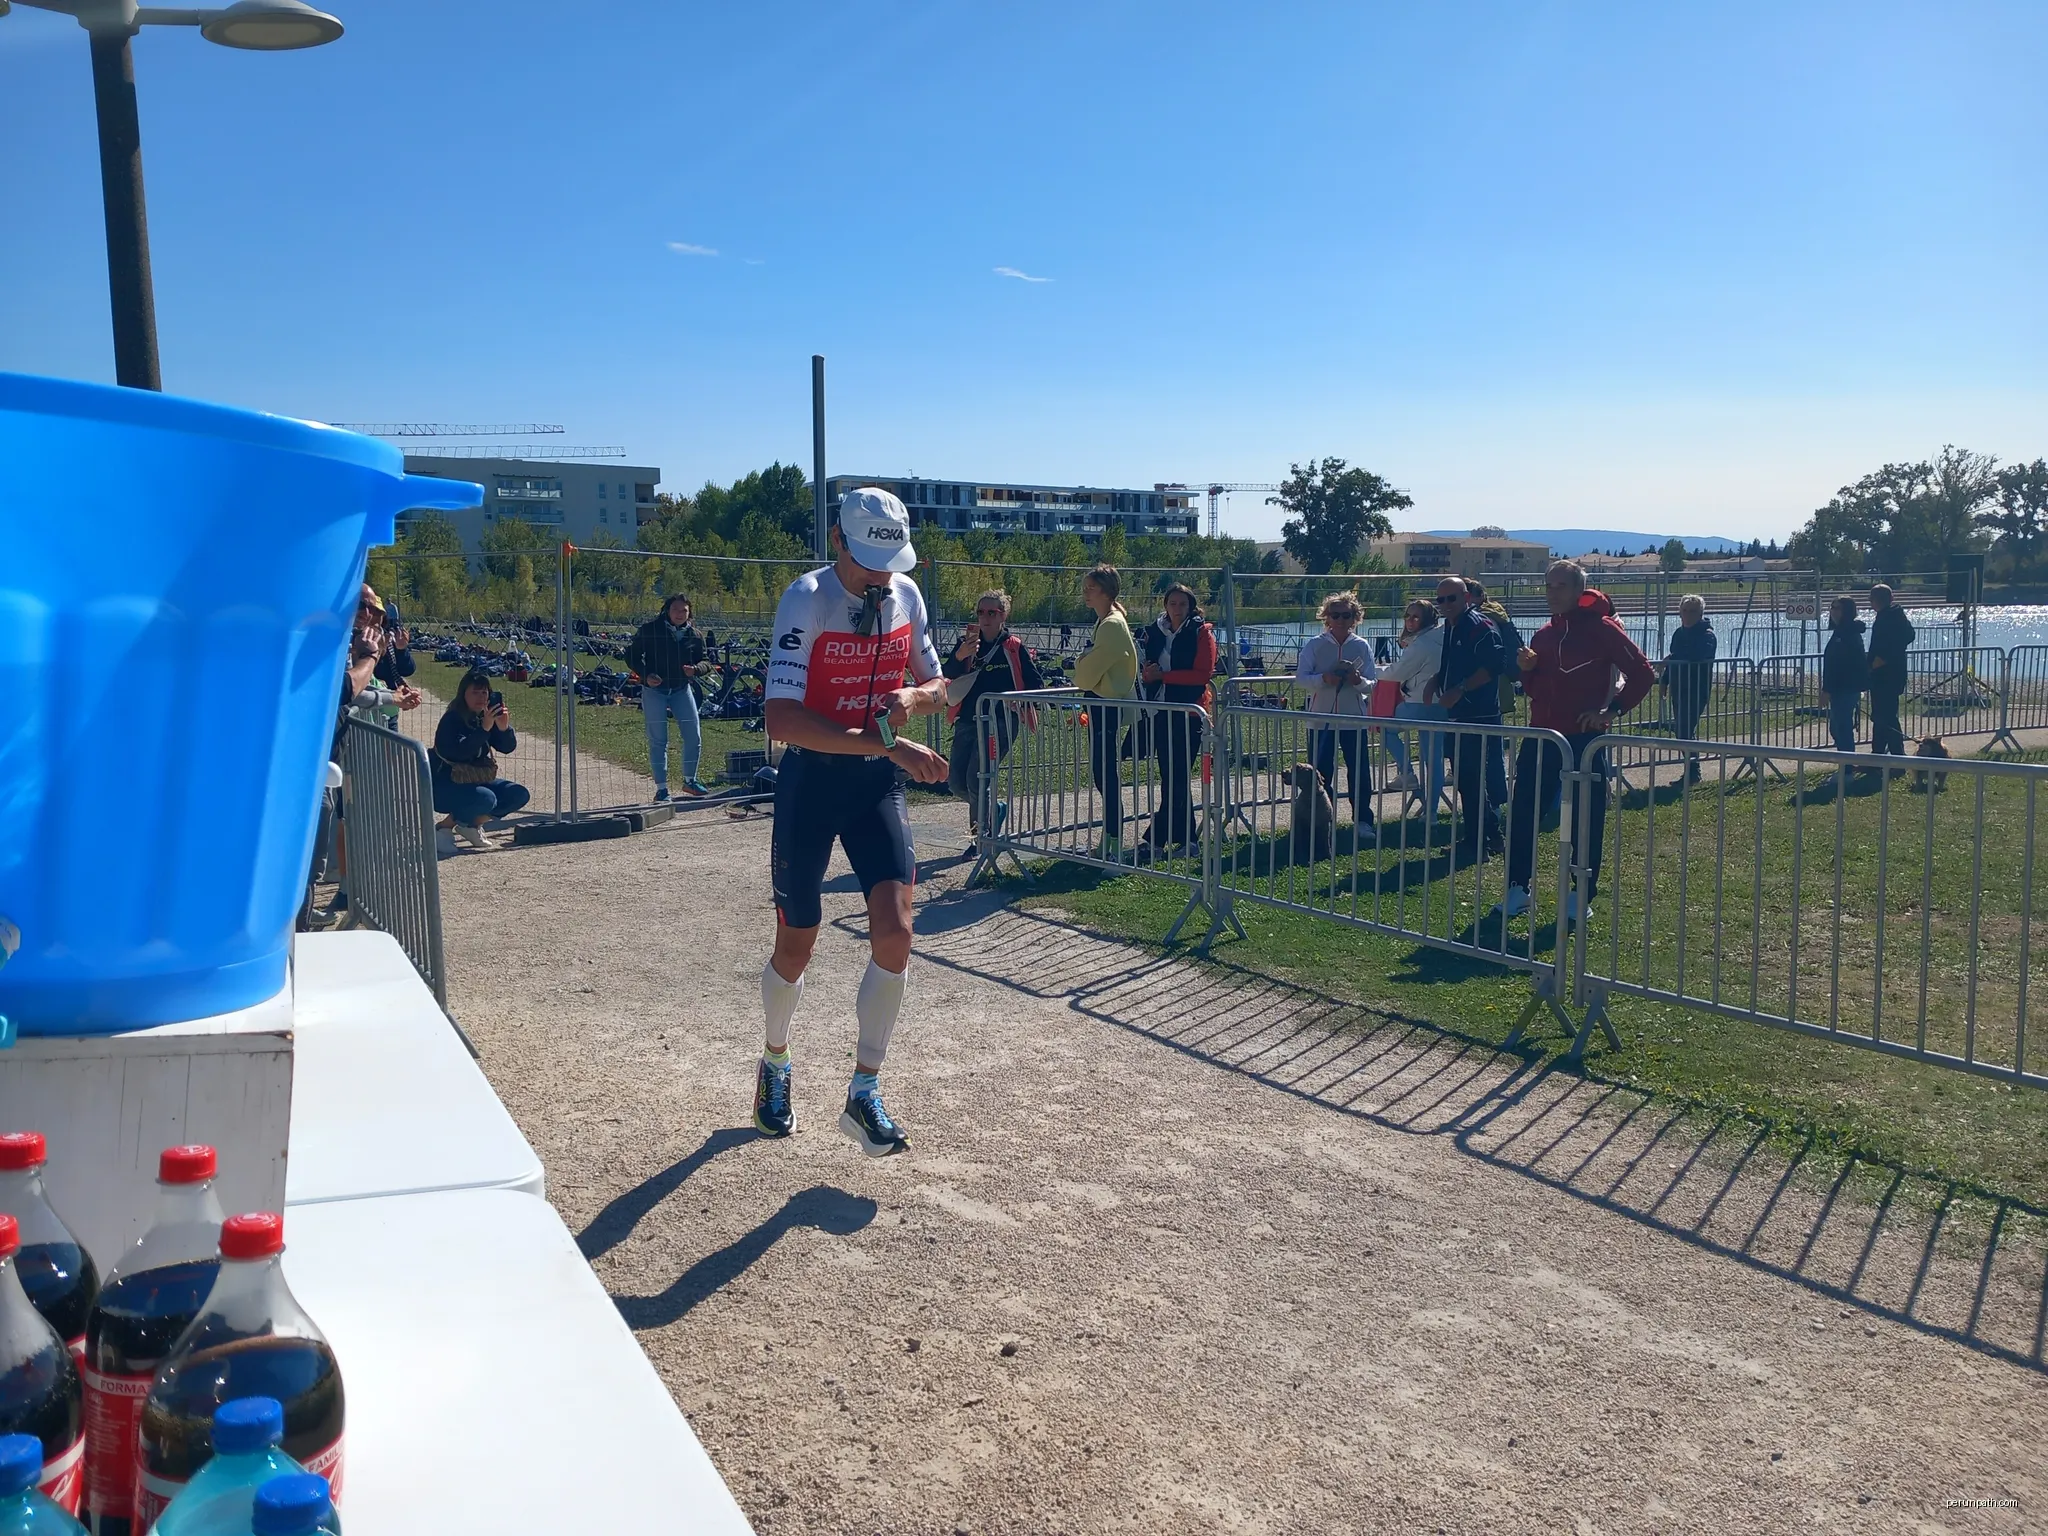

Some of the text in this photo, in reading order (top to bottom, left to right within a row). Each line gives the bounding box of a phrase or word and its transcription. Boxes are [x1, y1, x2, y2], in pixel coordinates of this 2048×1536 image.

[867, 526, 904, 541] HOKA
[824, 635, 910, 658] ROUGEOT
[771, 677, 806, 690] HUUB
[830, 670, 903, 685] cervélo
[836, 694, 887, 711] HOK
[308, 1446, 341, 1473] FAMIL
